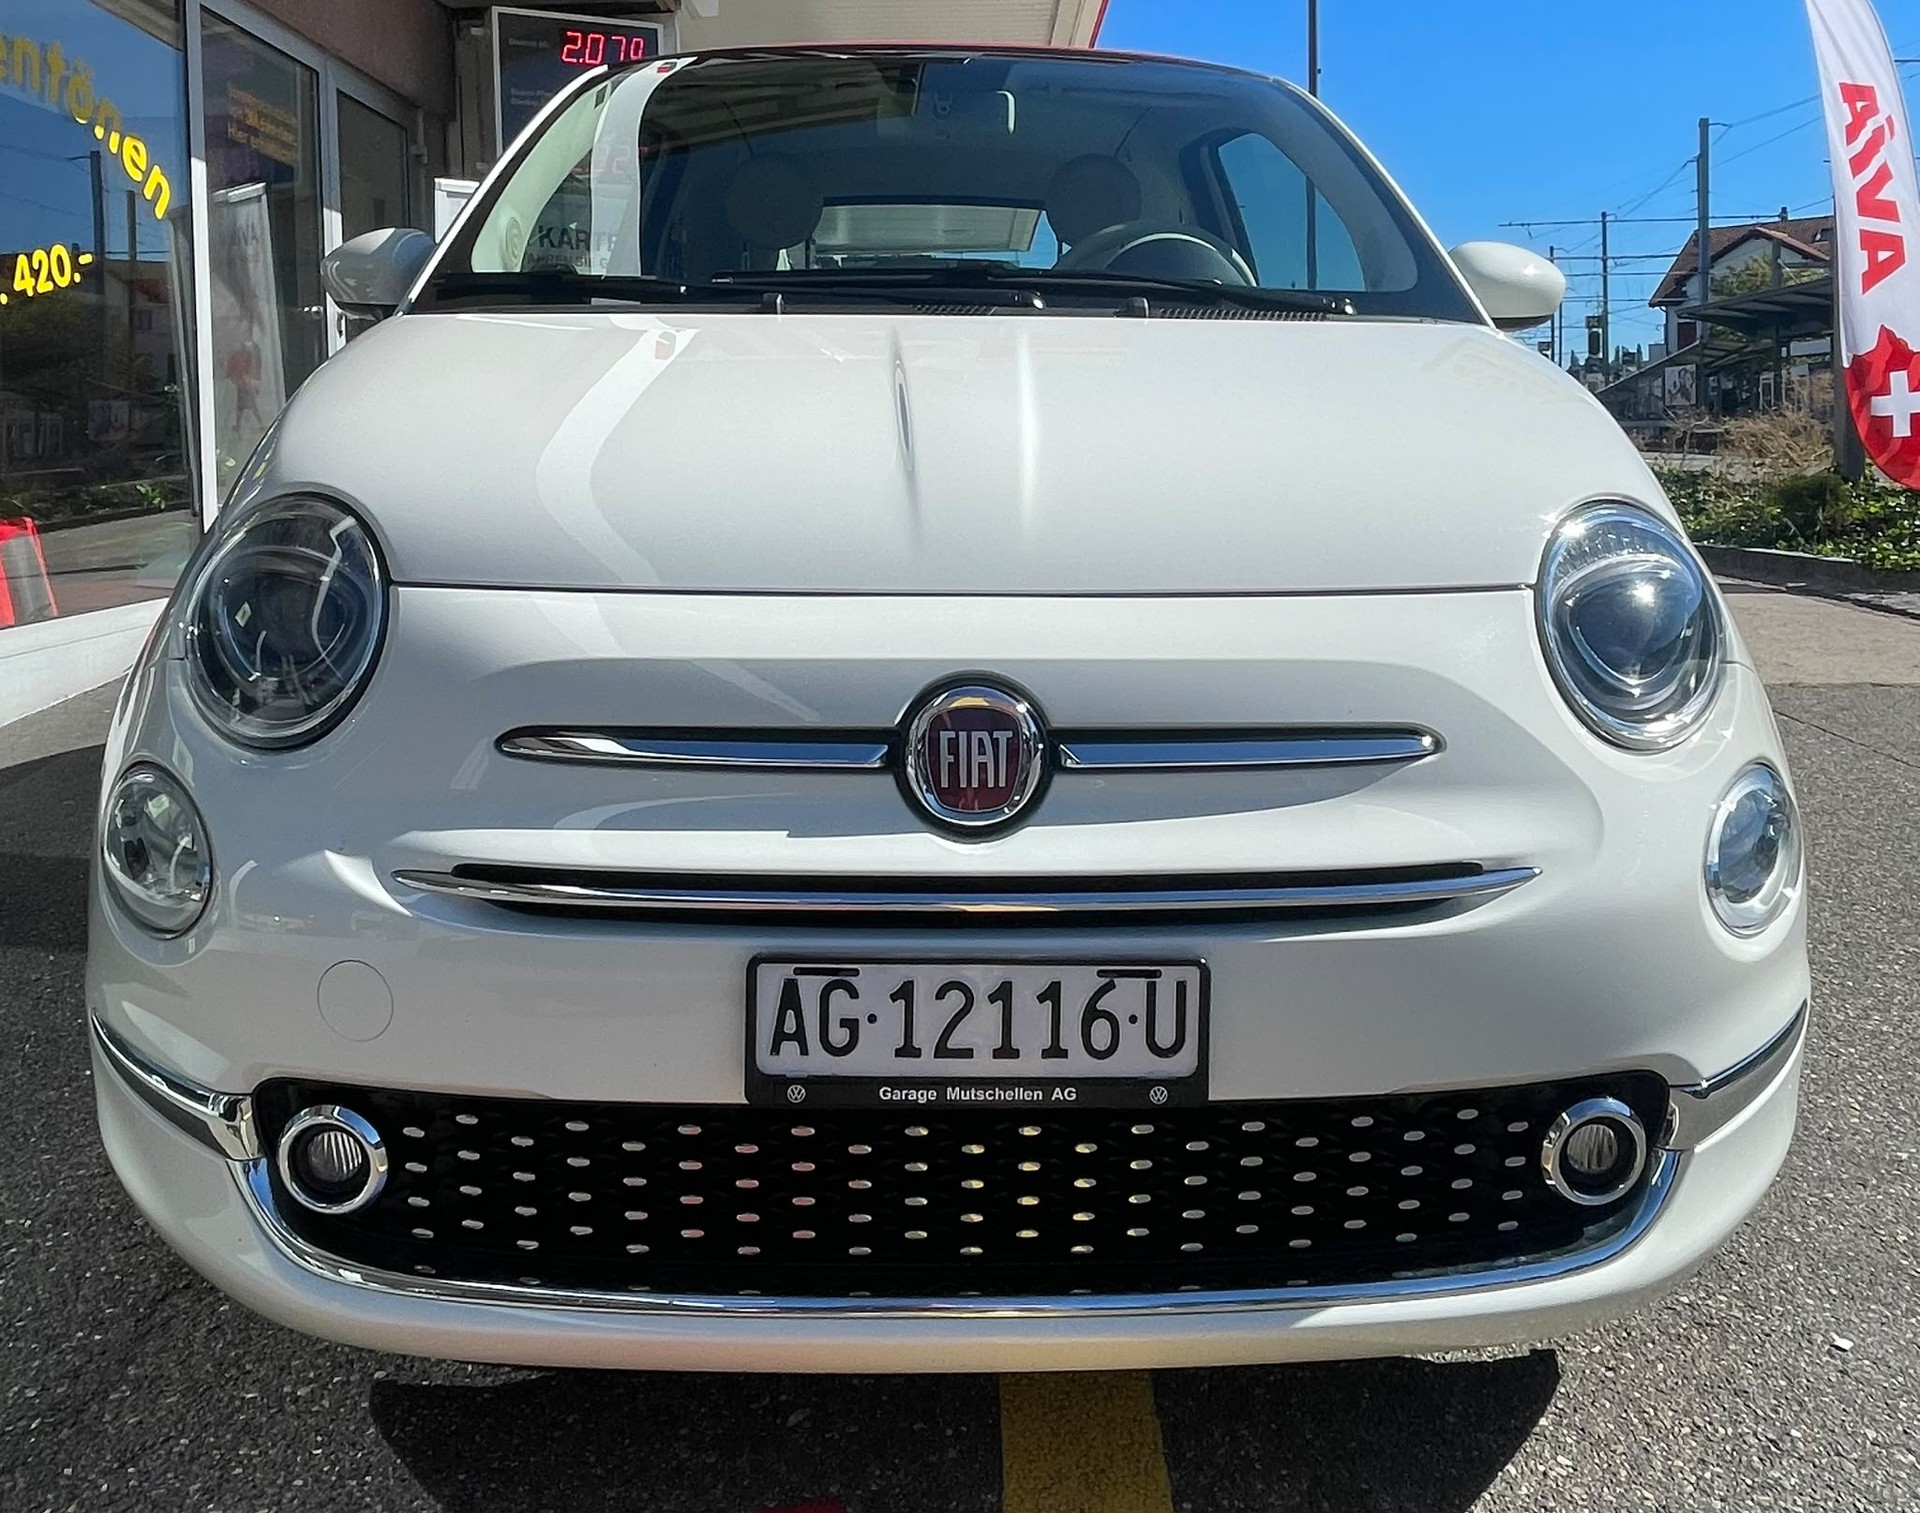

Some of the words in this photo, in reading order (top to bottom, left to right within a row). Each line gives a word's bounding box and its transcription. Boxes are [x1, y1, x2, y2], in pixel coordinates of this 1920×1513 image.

[939, 730, 1013, 788] FIAT
[879, 1086, 937, 1103] Garage
[946, 1086, 1043, 1101] Mutschellen
[1051, 1087, 1077, 1101] AG
